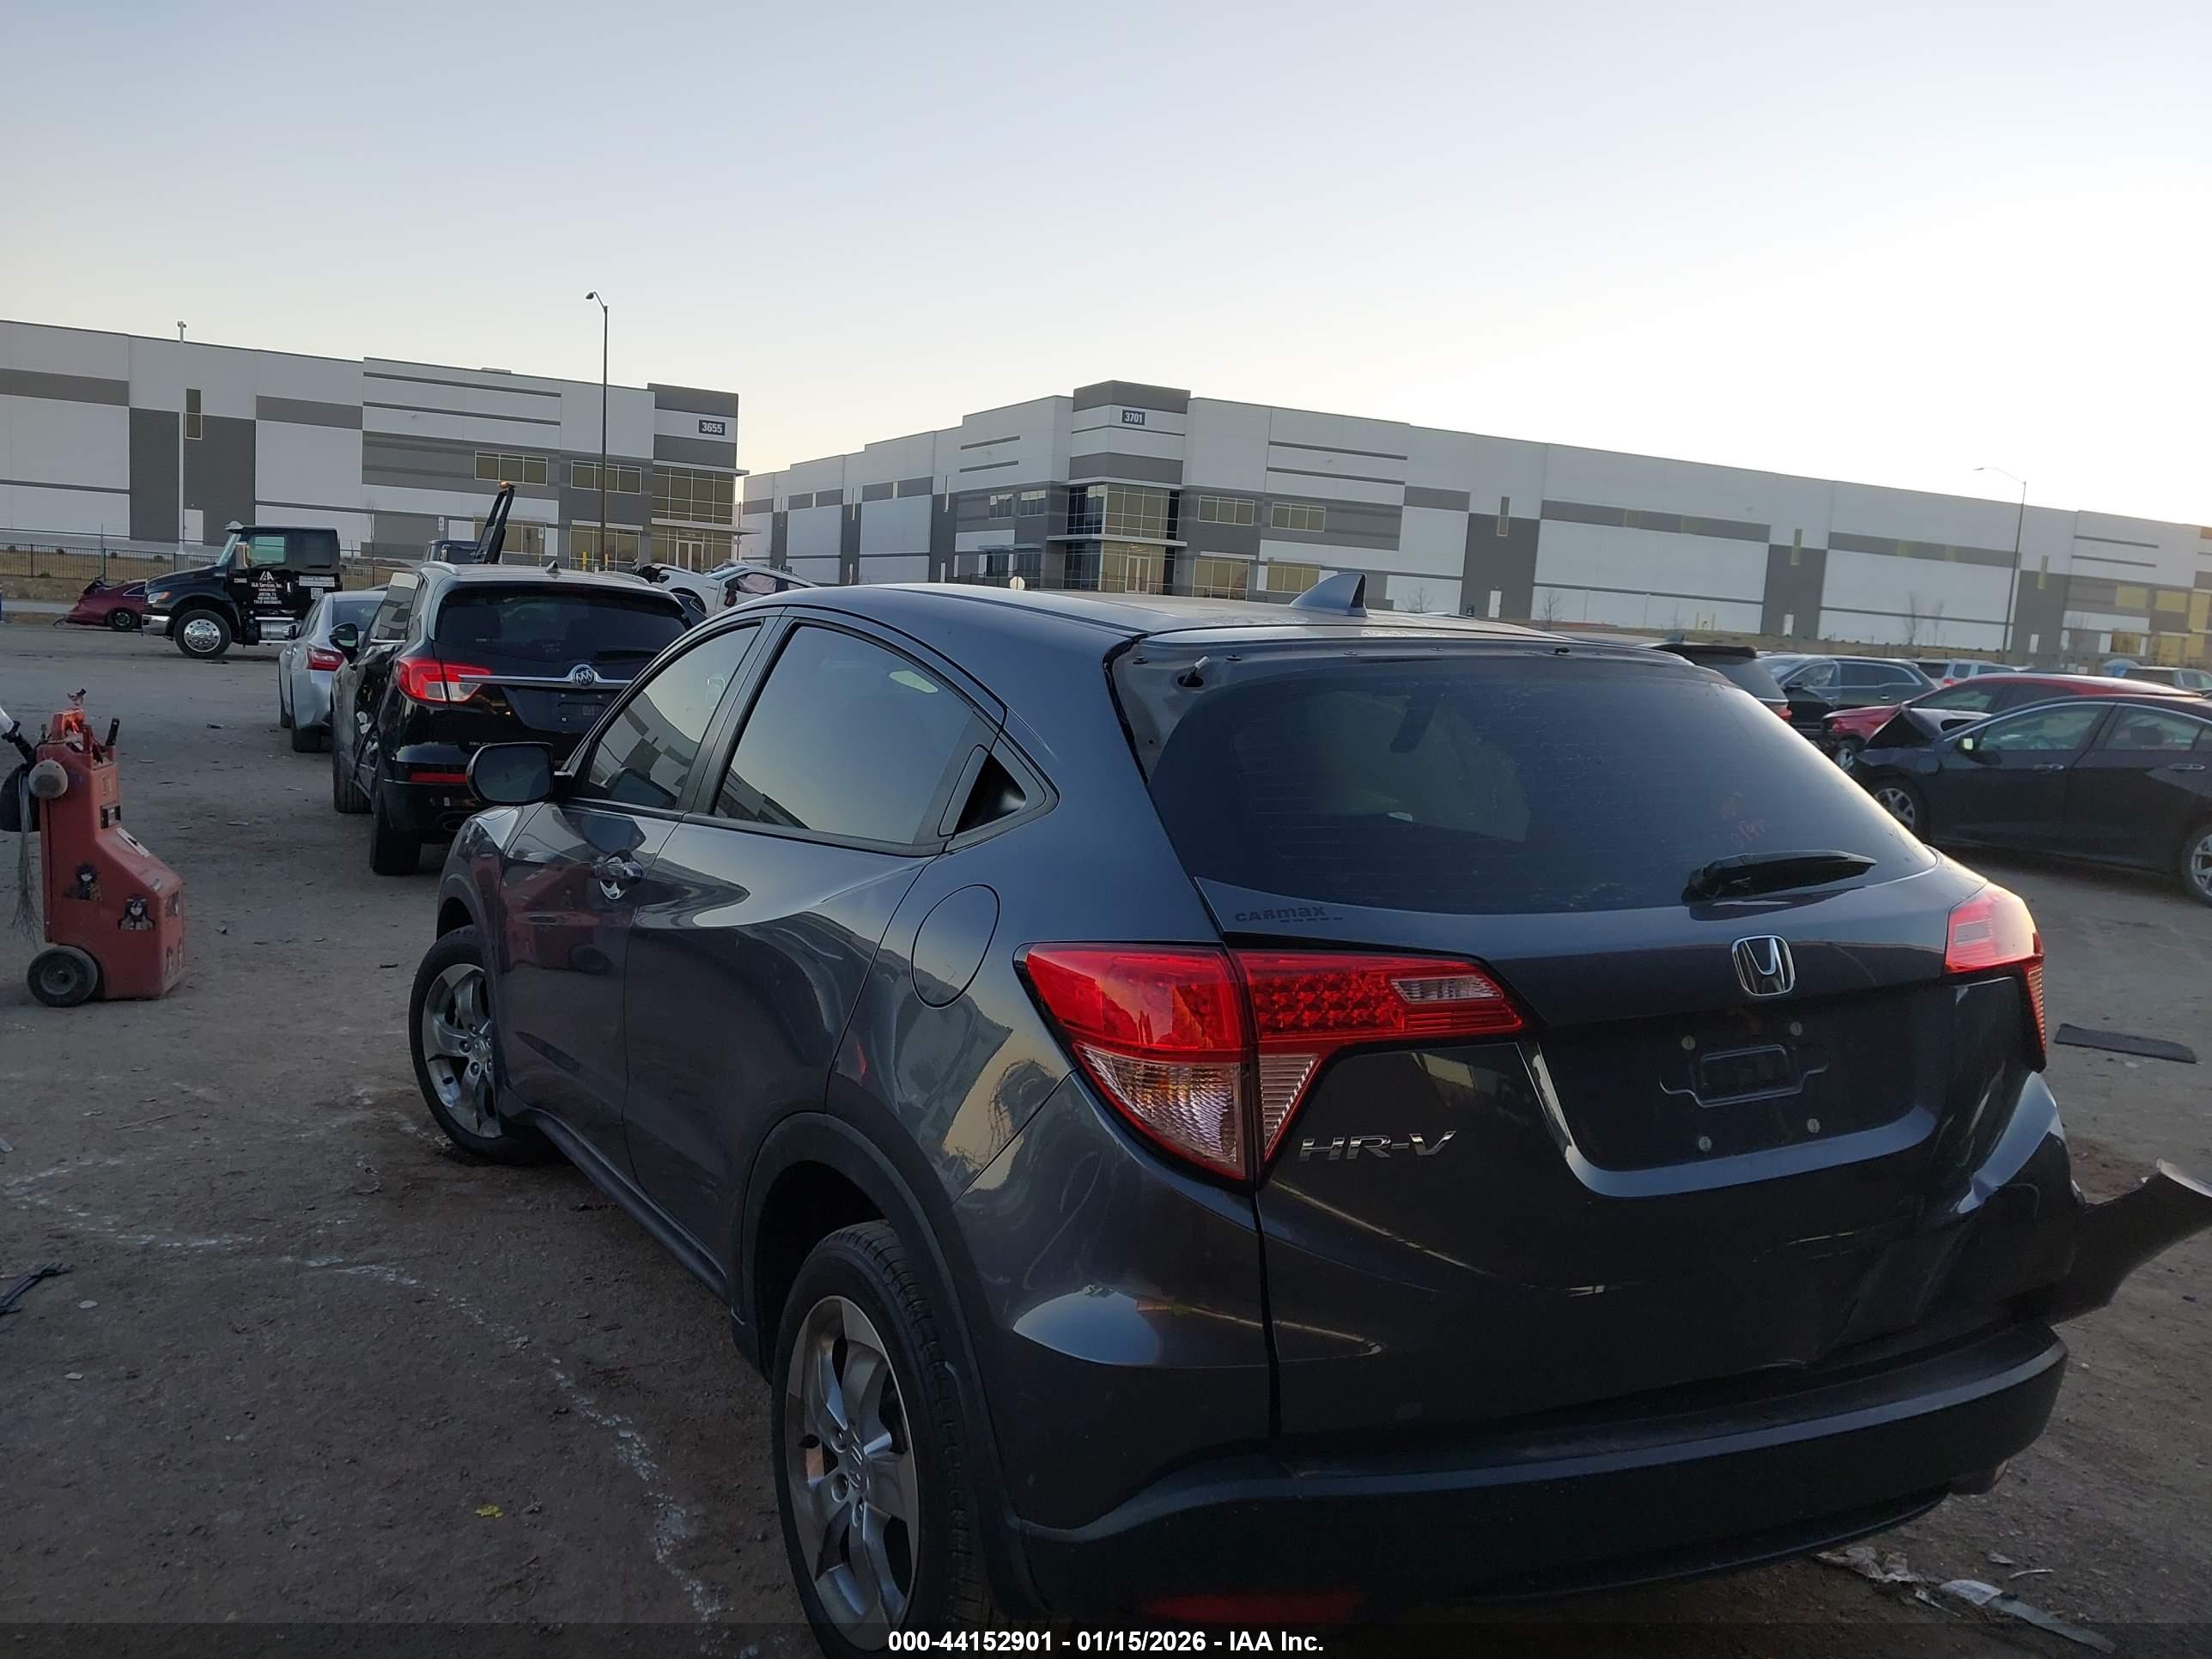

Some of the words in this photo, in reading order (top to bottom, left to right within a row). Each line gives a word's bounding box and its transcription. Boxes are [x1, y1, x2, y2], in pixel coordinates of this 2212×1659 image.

[1125, 412, 1143, 423] 3701
[702, 422, 723, 434] 3655
[1298, 1130, 1457, 1161] HR-V
